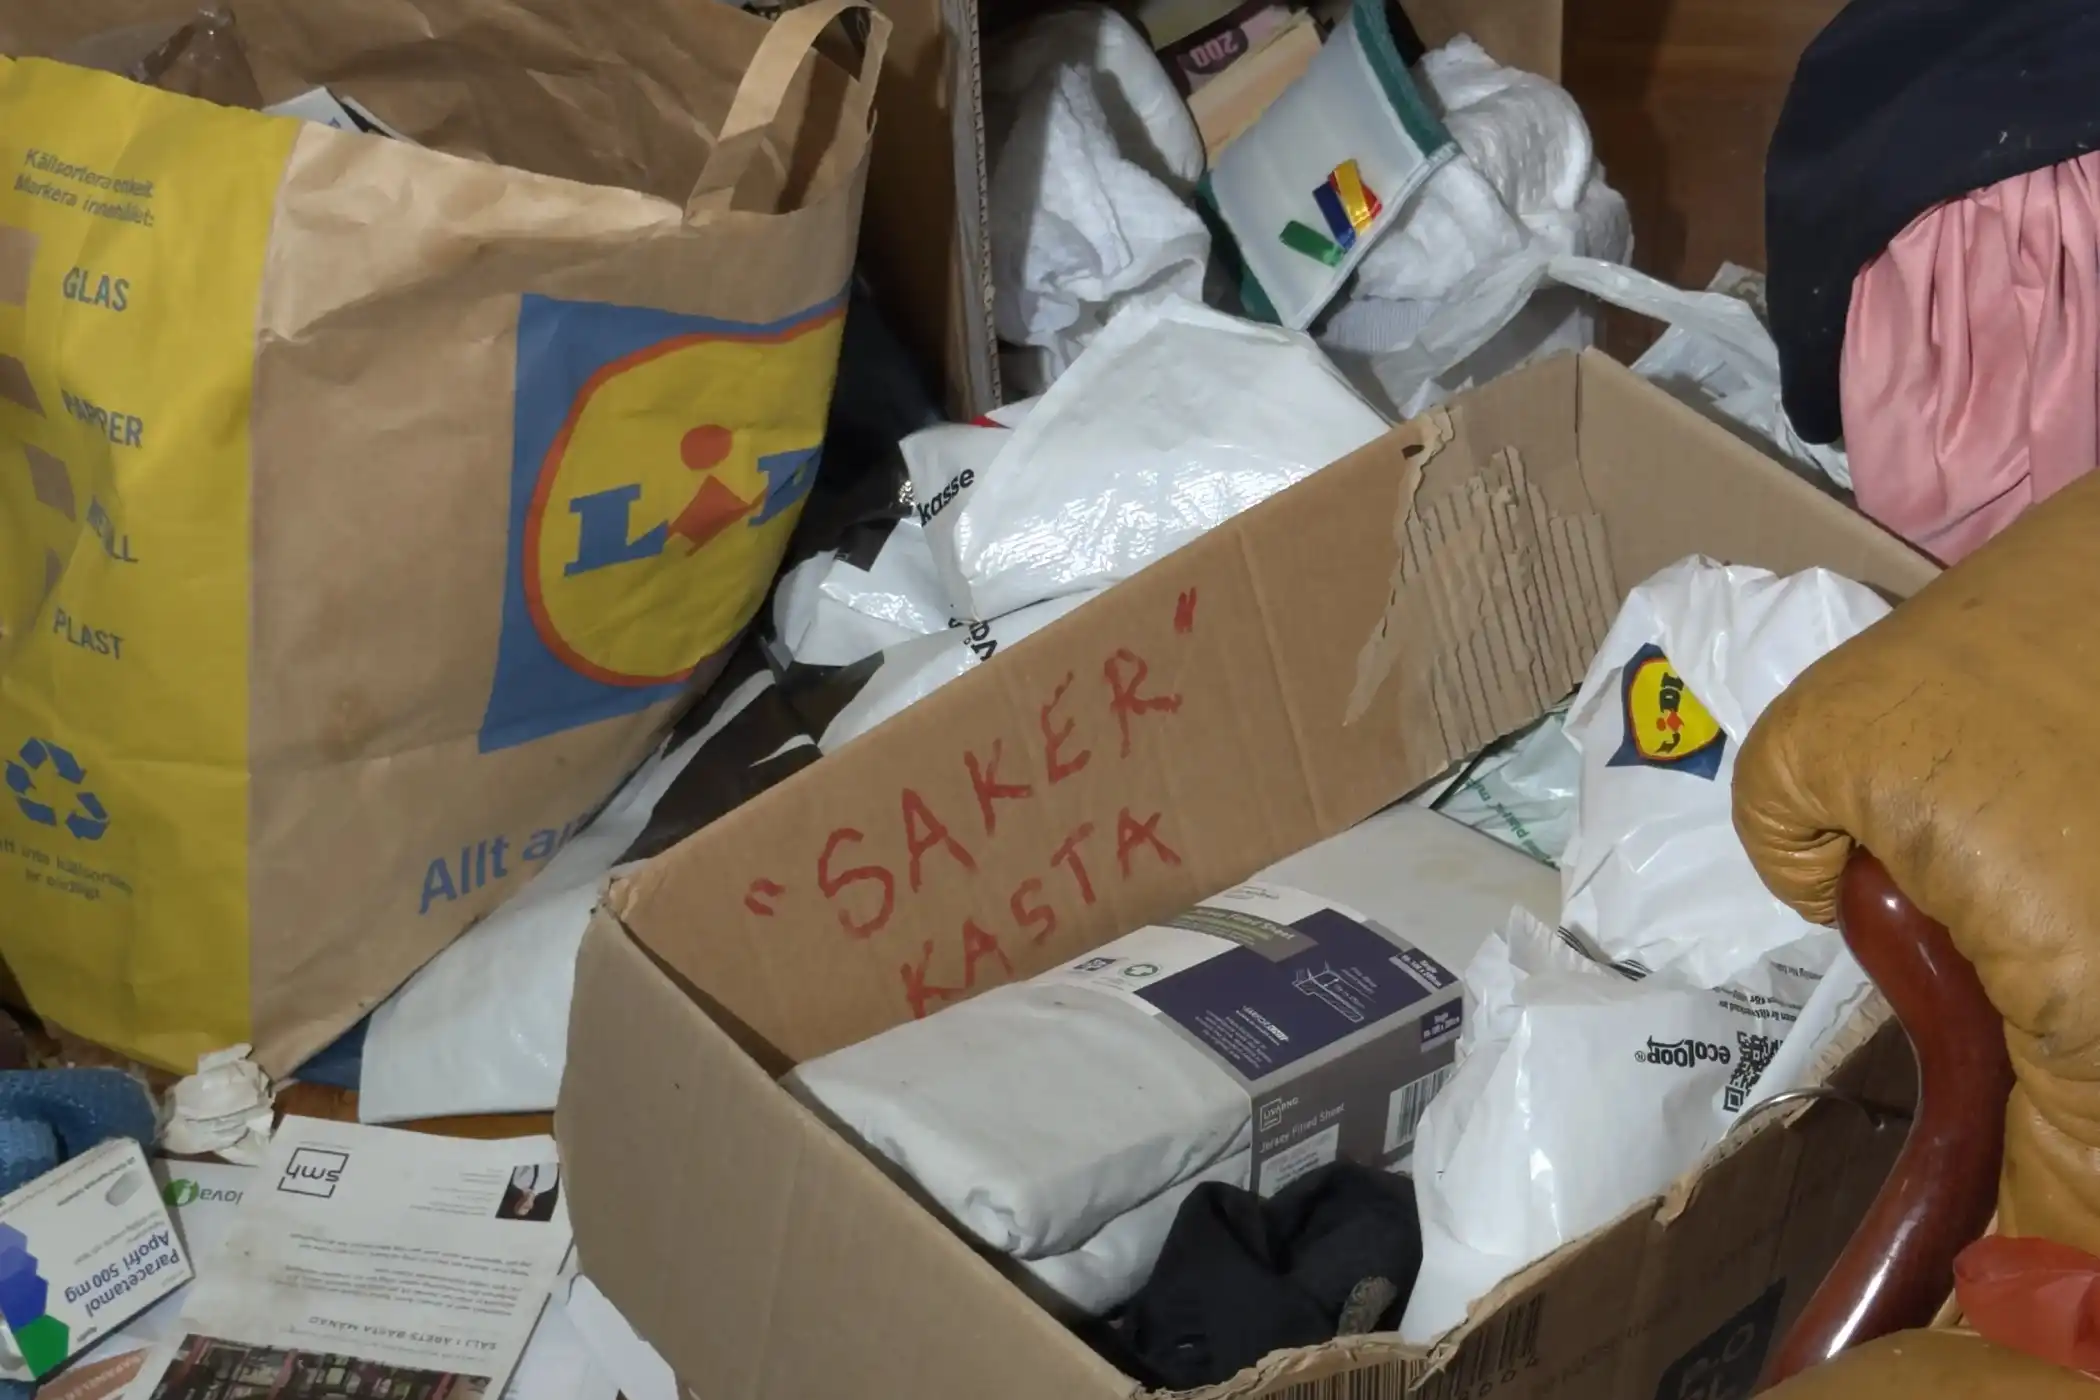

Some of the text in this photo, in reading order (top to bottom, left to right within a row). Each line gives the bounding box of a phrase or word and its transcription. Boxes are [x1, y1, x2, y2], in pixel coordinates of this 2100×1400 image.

[63, 266, 130, 312] GLAS
[53, 607, 125, 659] PLAST
[418, 834, 510, 915] Allt
[900, 806, 1182, 1020] KASTA
[64, 1229, 169, 1304] Apofri 500 mg
[84, 1247, 180, 1318] Paracetamol
